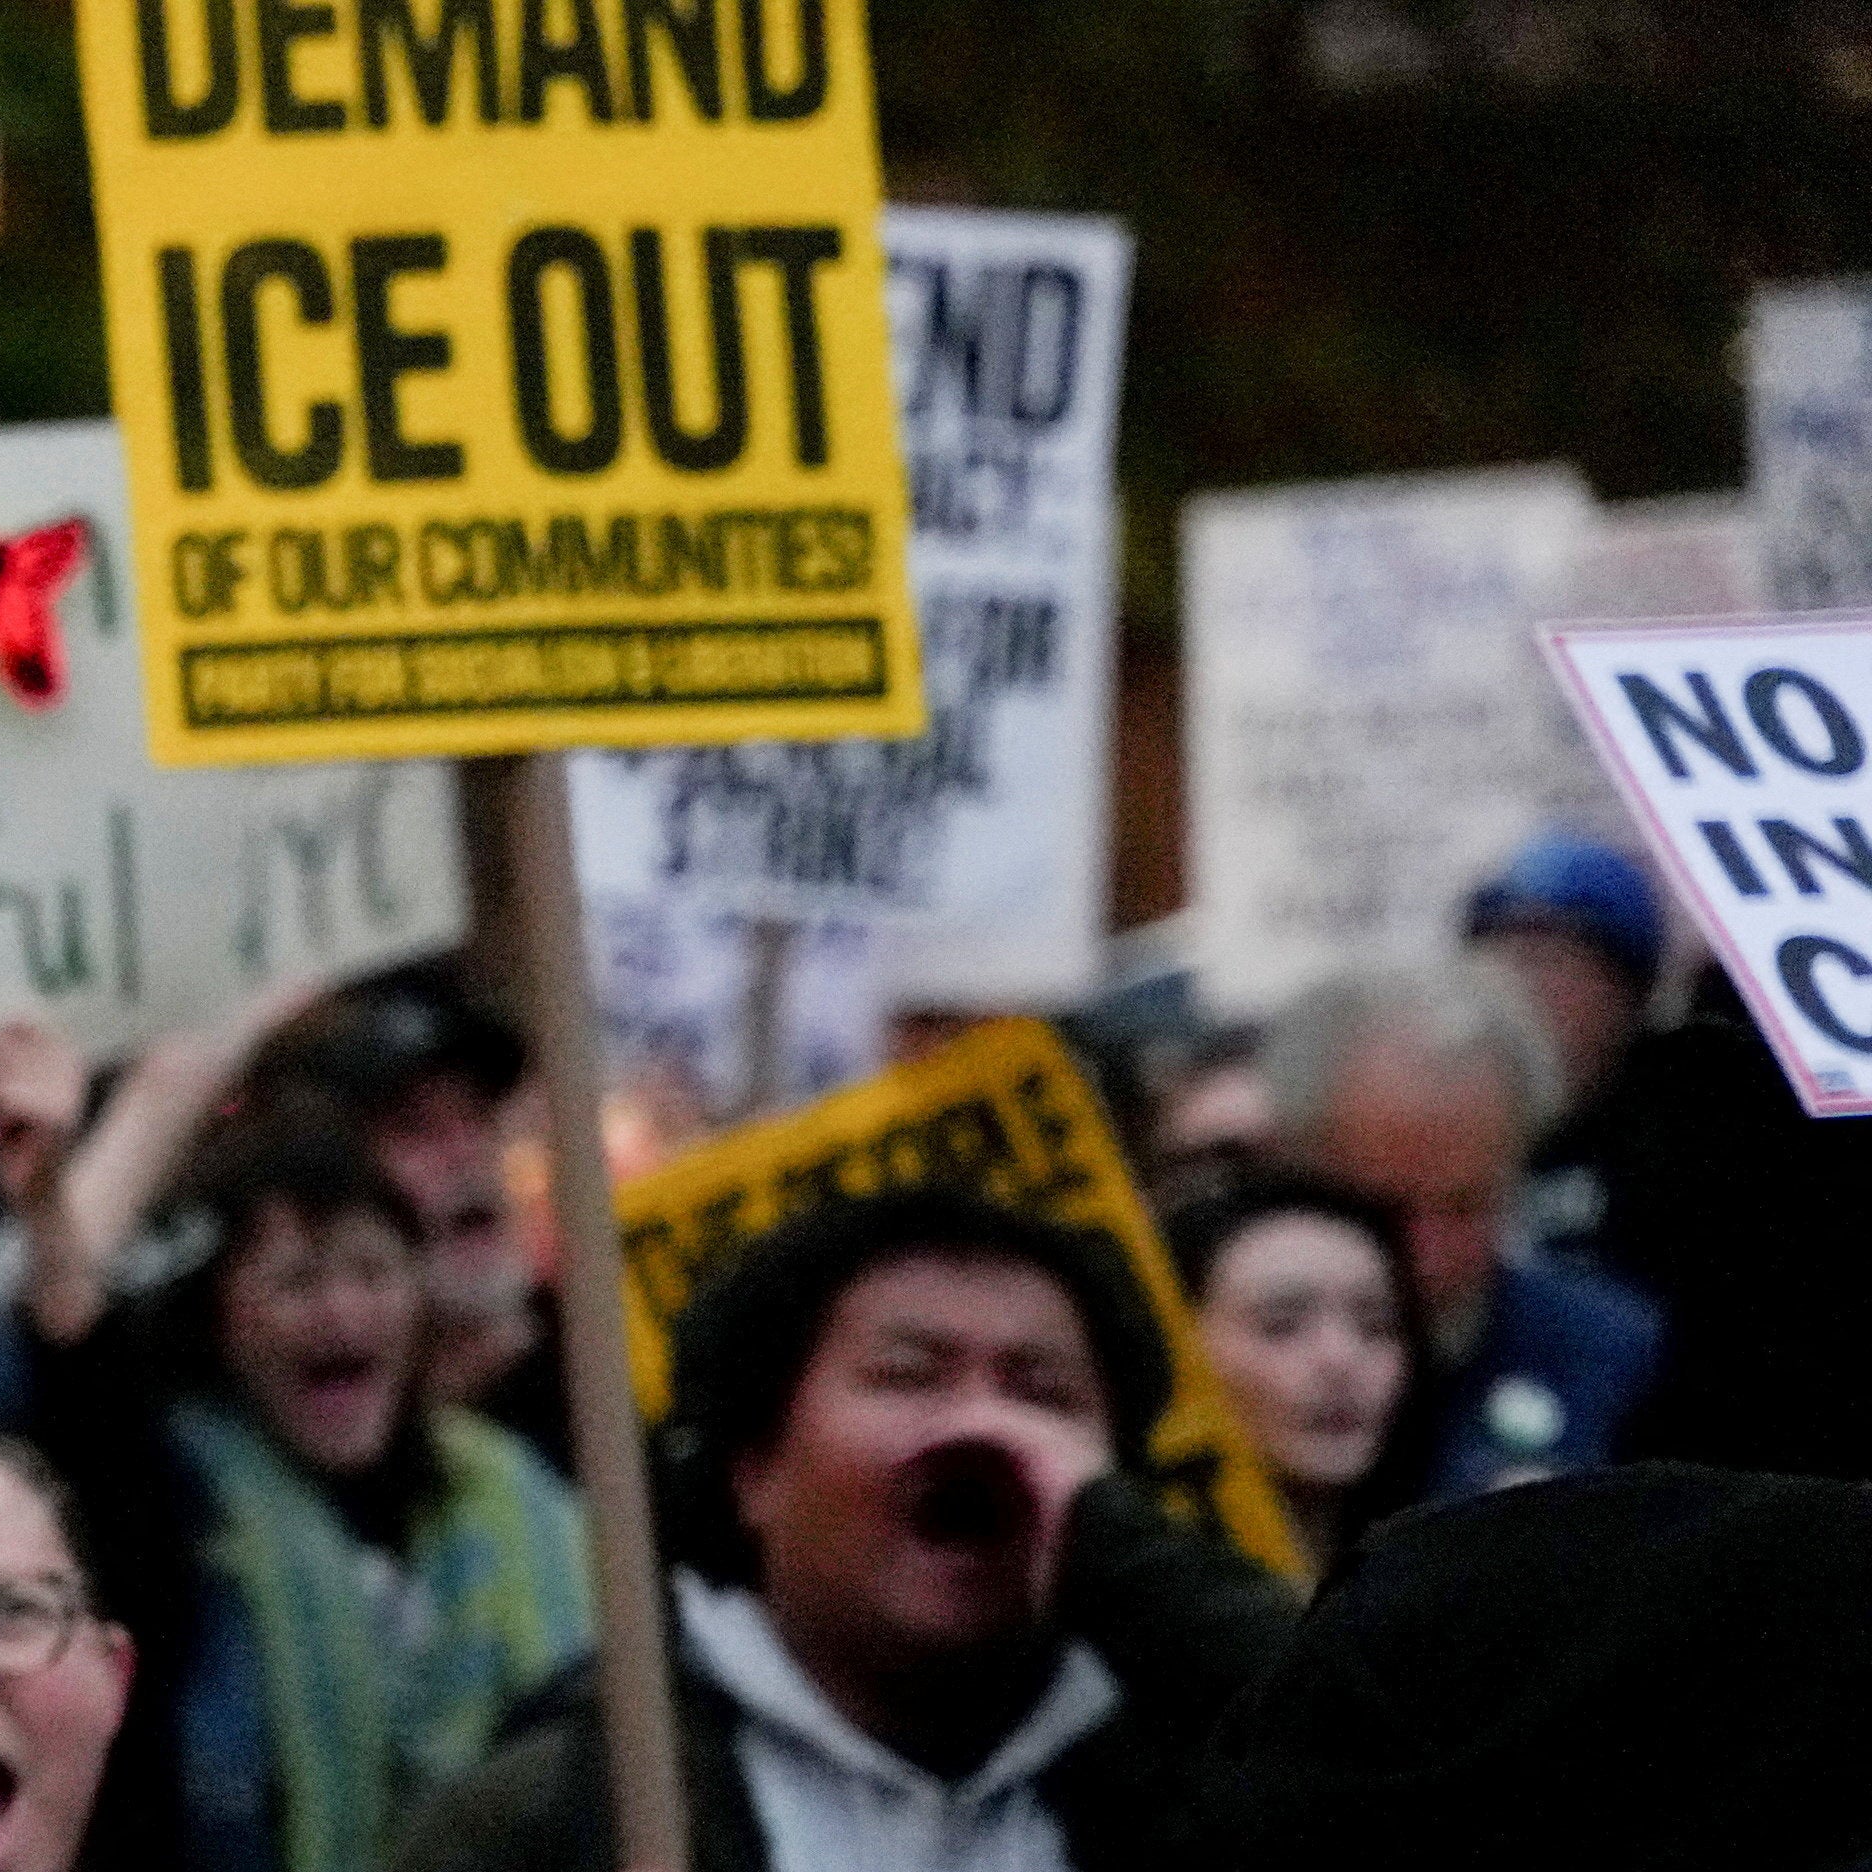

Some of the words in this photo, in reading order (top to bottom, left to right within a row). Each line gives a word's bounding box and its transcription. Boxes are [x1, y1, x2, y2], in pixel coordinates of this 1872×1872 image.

[136, 0, 833, 139] DEMAND
[157, 231, 465, 493] ICE
[504, 225, 842, 476] OUT
[171, 527, 249, 620] OF
[266, 520, 405, 611] OUR
[417, 505, 876, 606] COMMUNITIES!
[1616, 666, 1866, 779] NO
